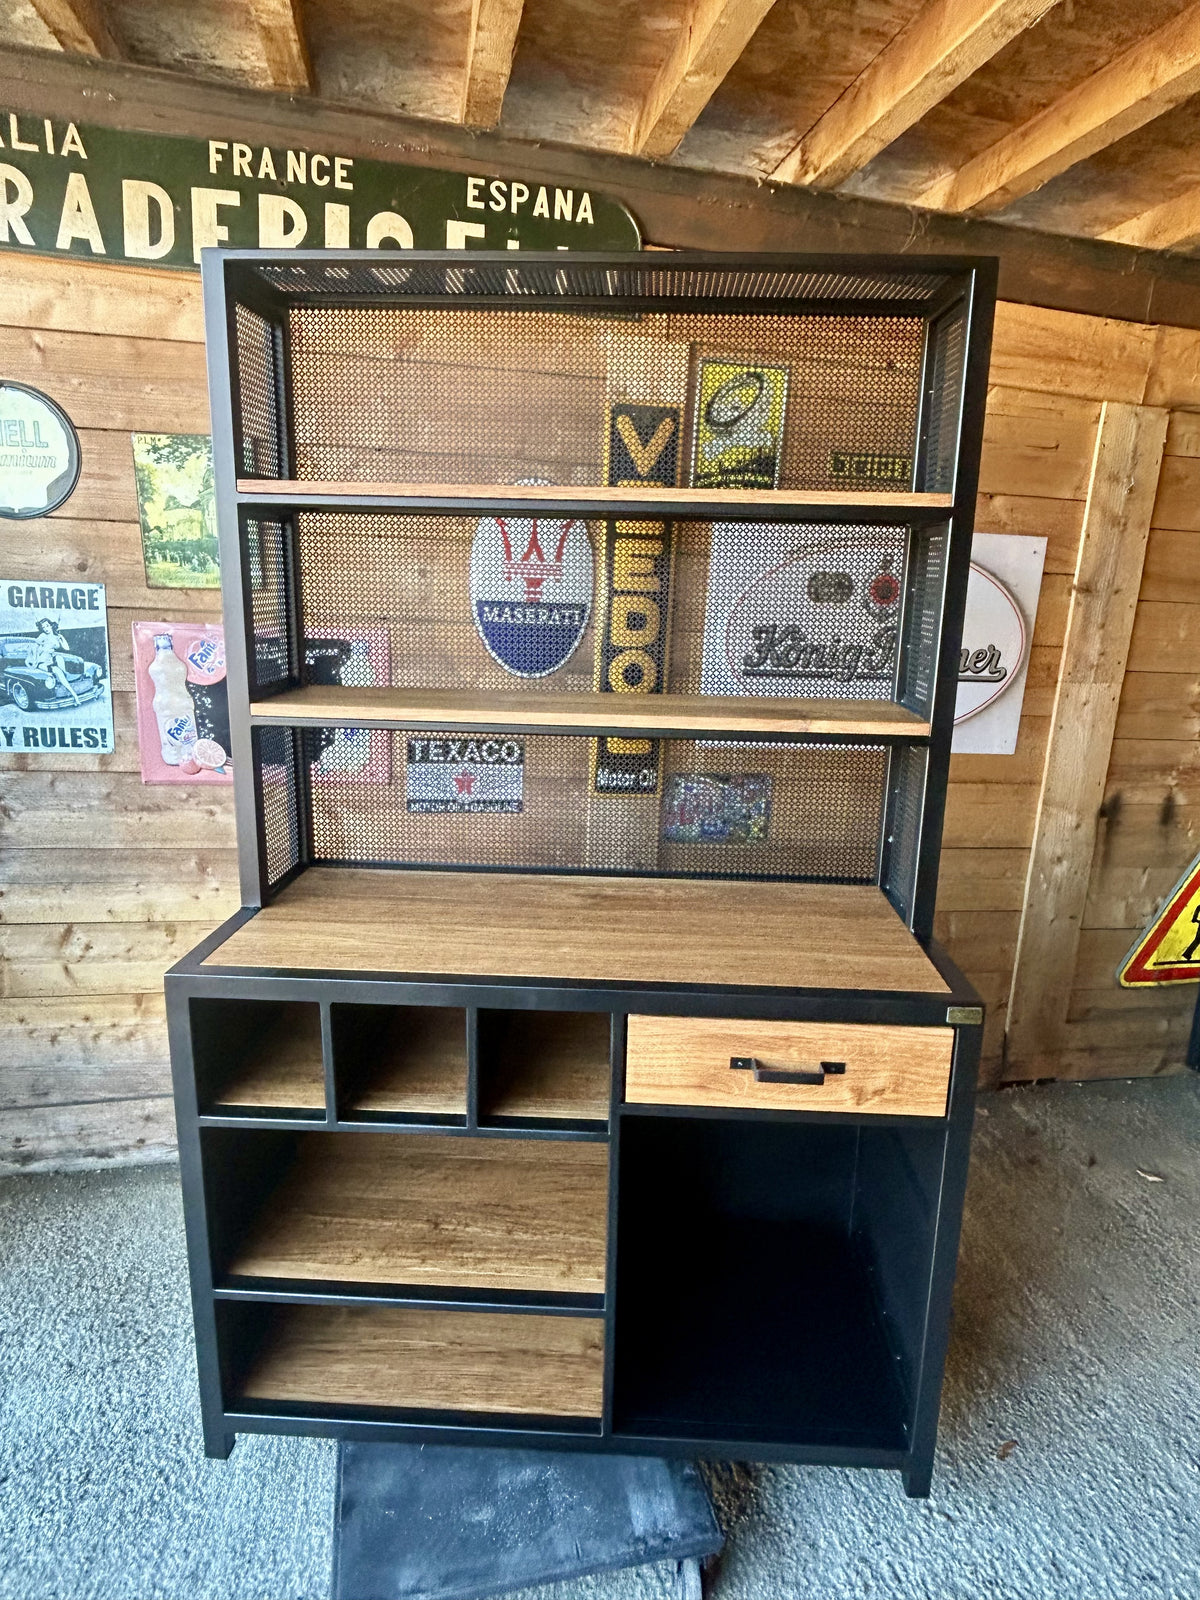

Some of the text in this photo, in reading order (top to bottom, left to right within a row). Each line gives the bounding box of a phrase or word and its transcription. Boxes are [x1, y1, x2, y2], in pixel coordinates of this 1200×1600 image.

[0, 113, 88, 160] LIA
[208, 140, 355, 191] FRANCE
[466, 176, 594, 225] ESPANA
[0, 419, 50, 449] ELL
[7, 585, 100, 611] GARAGE
[483, 606, 582, 626] MASERATI
[22, 727, 108, 749] RULES!
[409, 740, 521, 762] TEXACO
